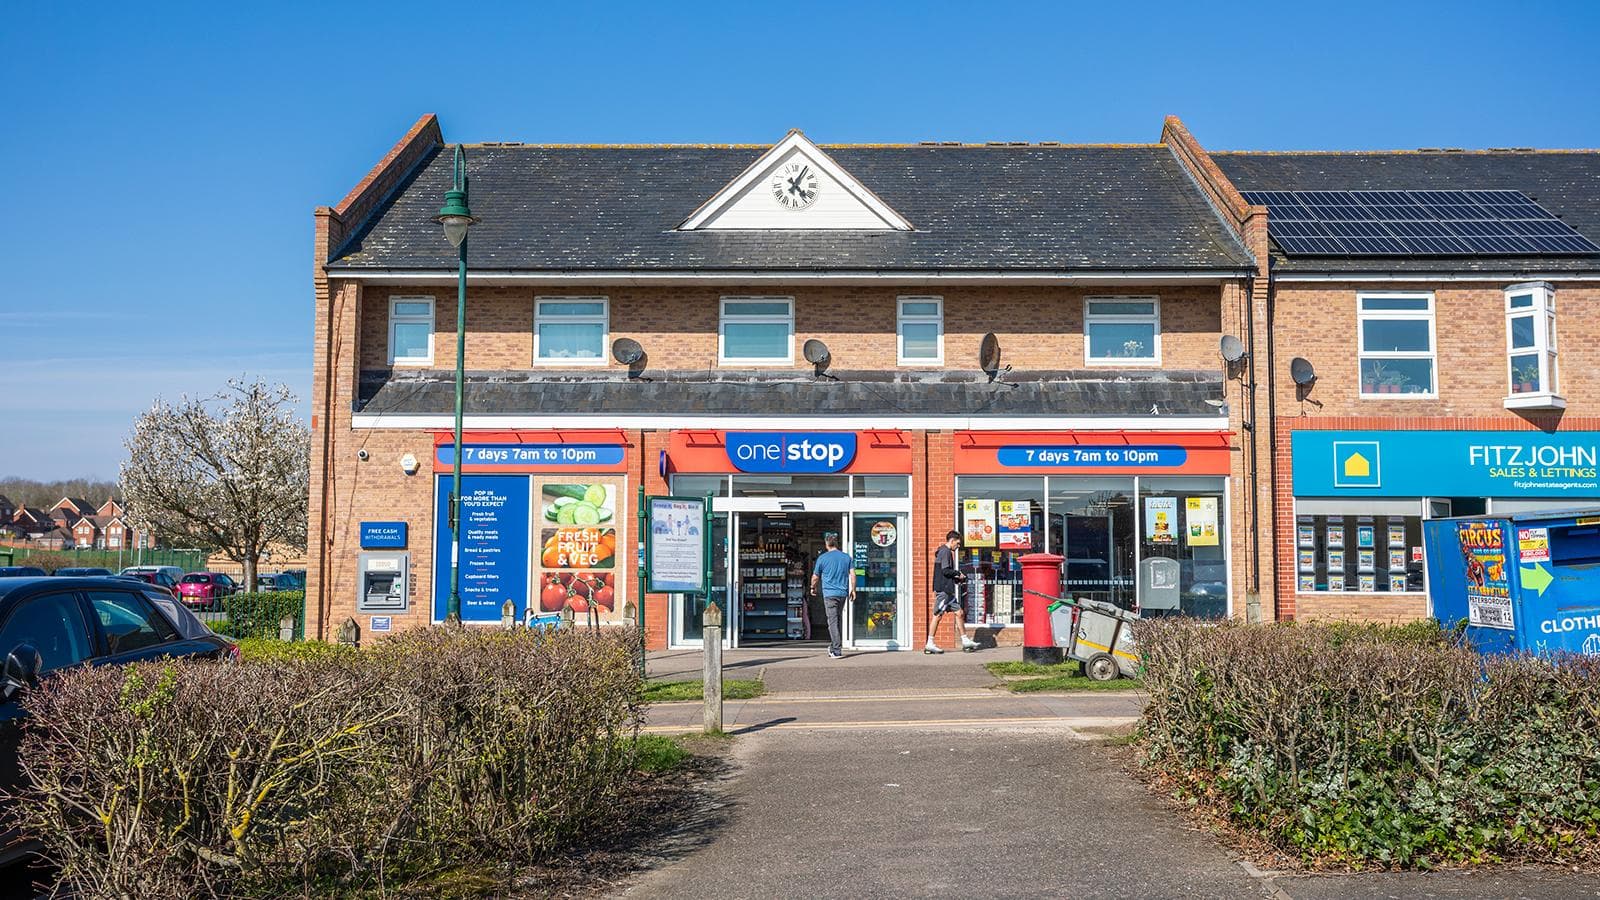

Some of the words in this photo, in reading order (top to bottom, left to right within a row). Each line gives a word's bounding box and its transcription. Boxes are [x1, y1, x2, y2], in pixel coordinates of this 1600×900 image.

[465, 448, 474, 459] 7
[478, 448, 508, 462] days
[512, 448, 540, 460] 7am
[544, 449, 558, 460] to
[562, 448, 596, 462] 10pm
[737, 444, 780, 460] one
[788, 439, 844, 467] stop
[1026, 450, 1034, 461] 7
[1039, 450, 1069, 463] days
[1074, 450, 1100, 461] 7am
[1105, 451, 1120, 461] to
[1123, 450, 1158, 464] 10pm
[1469, 446, 1596, 466] FITZJOHN
[1490, 468, 1525, 478] SALES
[1529, 468, 1538, 478] &
[1541, 468, 1596, 478] LETTINGS
[1513, 481, 1597, 489] fitzjohnestateagents.com
[558, 532, 598, 541] FRESH
[1460, 529, 1502, 546] CIRCUS
[1519, 531, 1530, 540] NO
[558, 542, 598, 552] FRUIT
[558, 554, 568, 565] &
[570, 554, 598, 565] VEG
